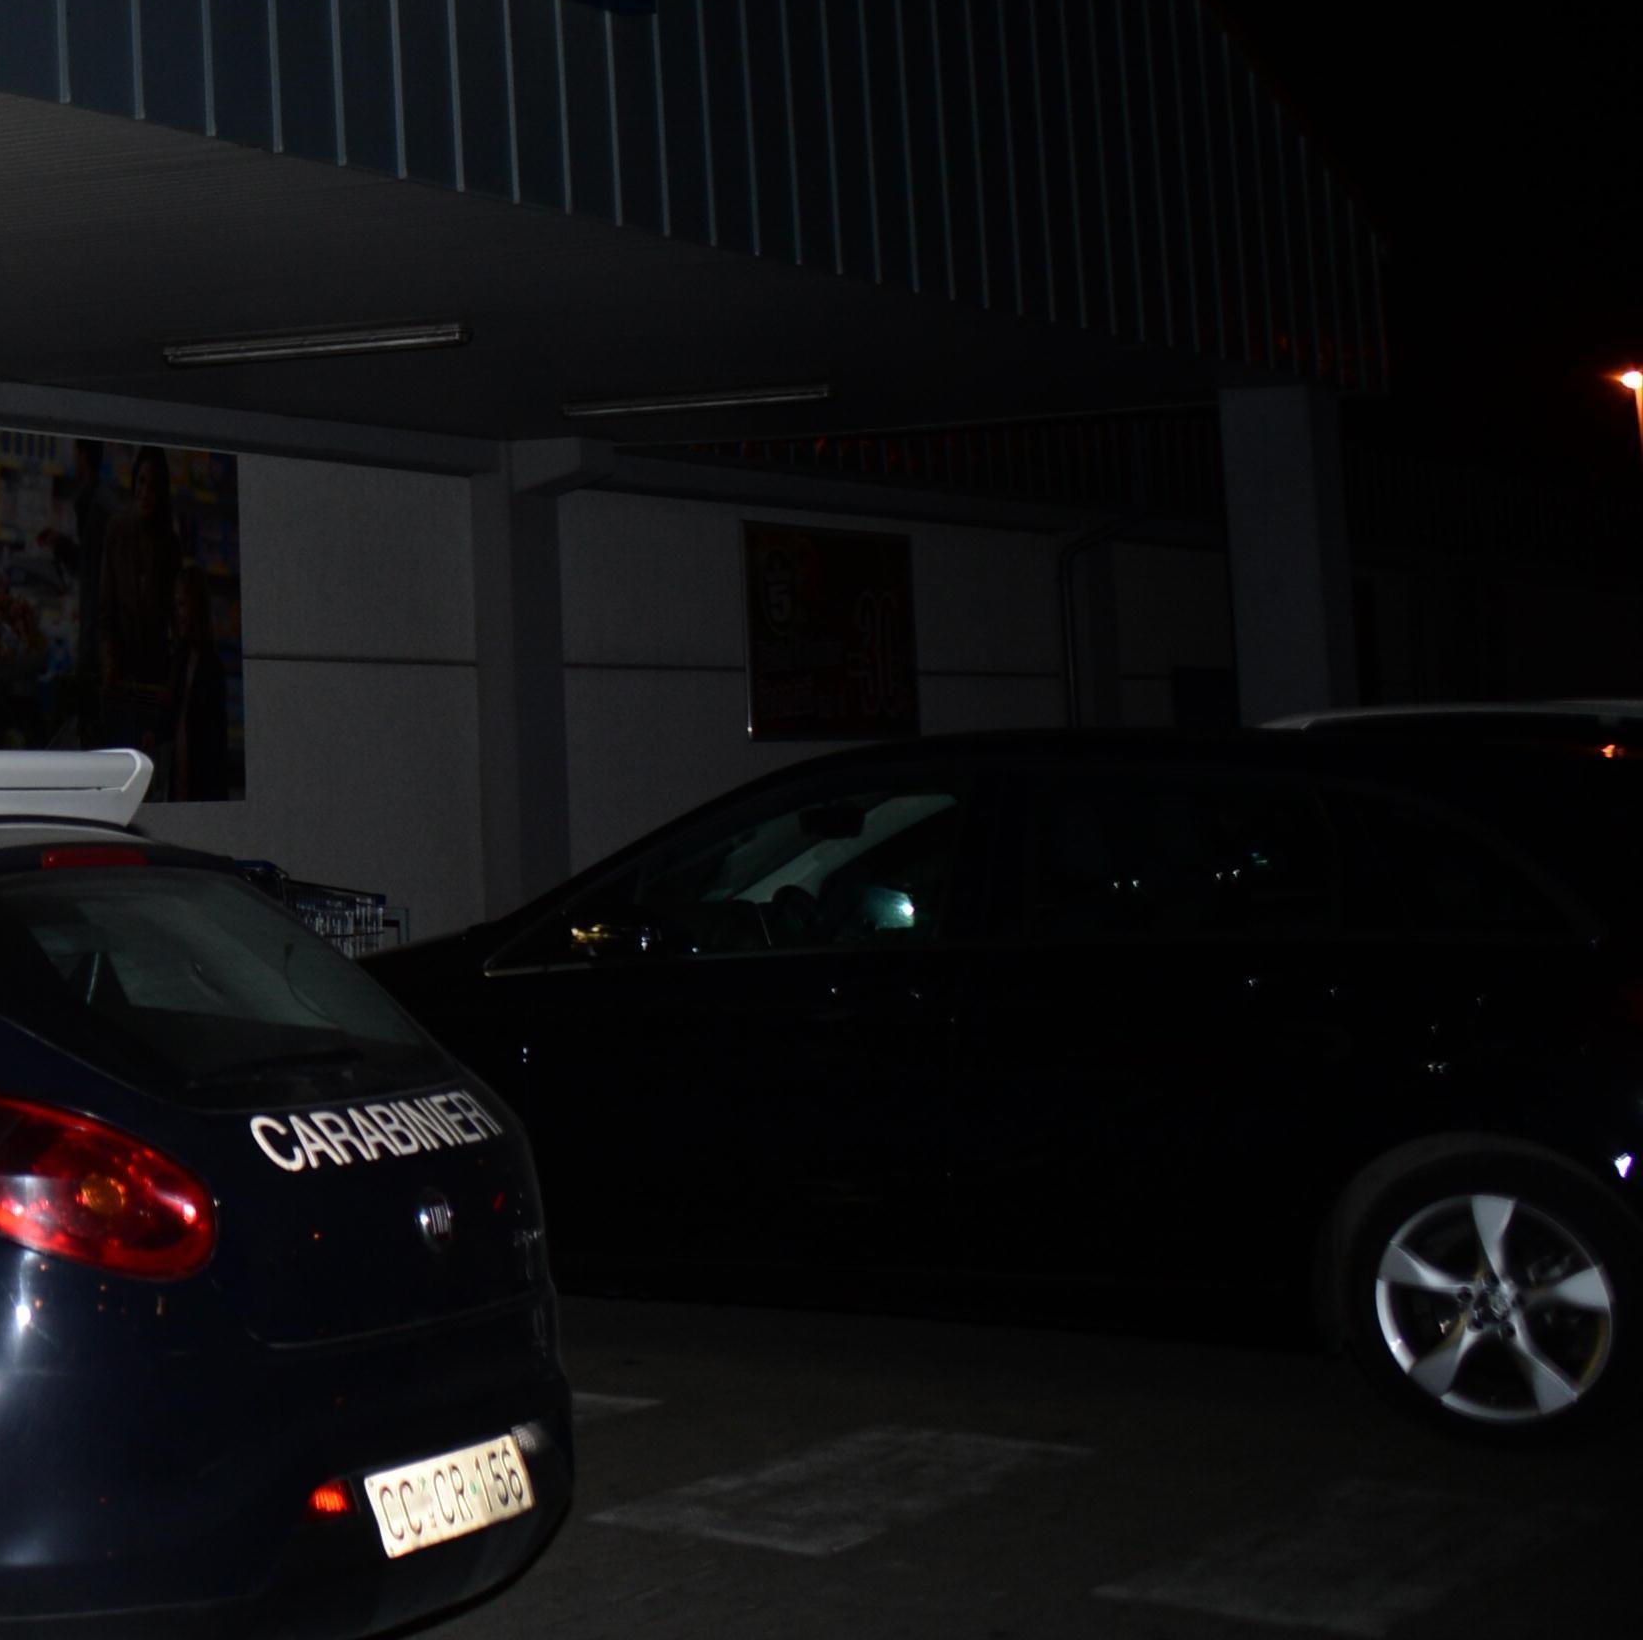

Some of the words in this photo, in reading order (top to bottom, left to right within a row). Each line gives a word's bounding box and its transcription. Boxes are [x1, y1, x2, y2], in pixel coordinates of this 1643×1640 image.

[249, 1089, 503, 1172] CARABINIERI
[378, 1479, 423, 1541] CC
[432, 1463, 474, 1526] CR
[474, 1445, 524, 1514] 156
